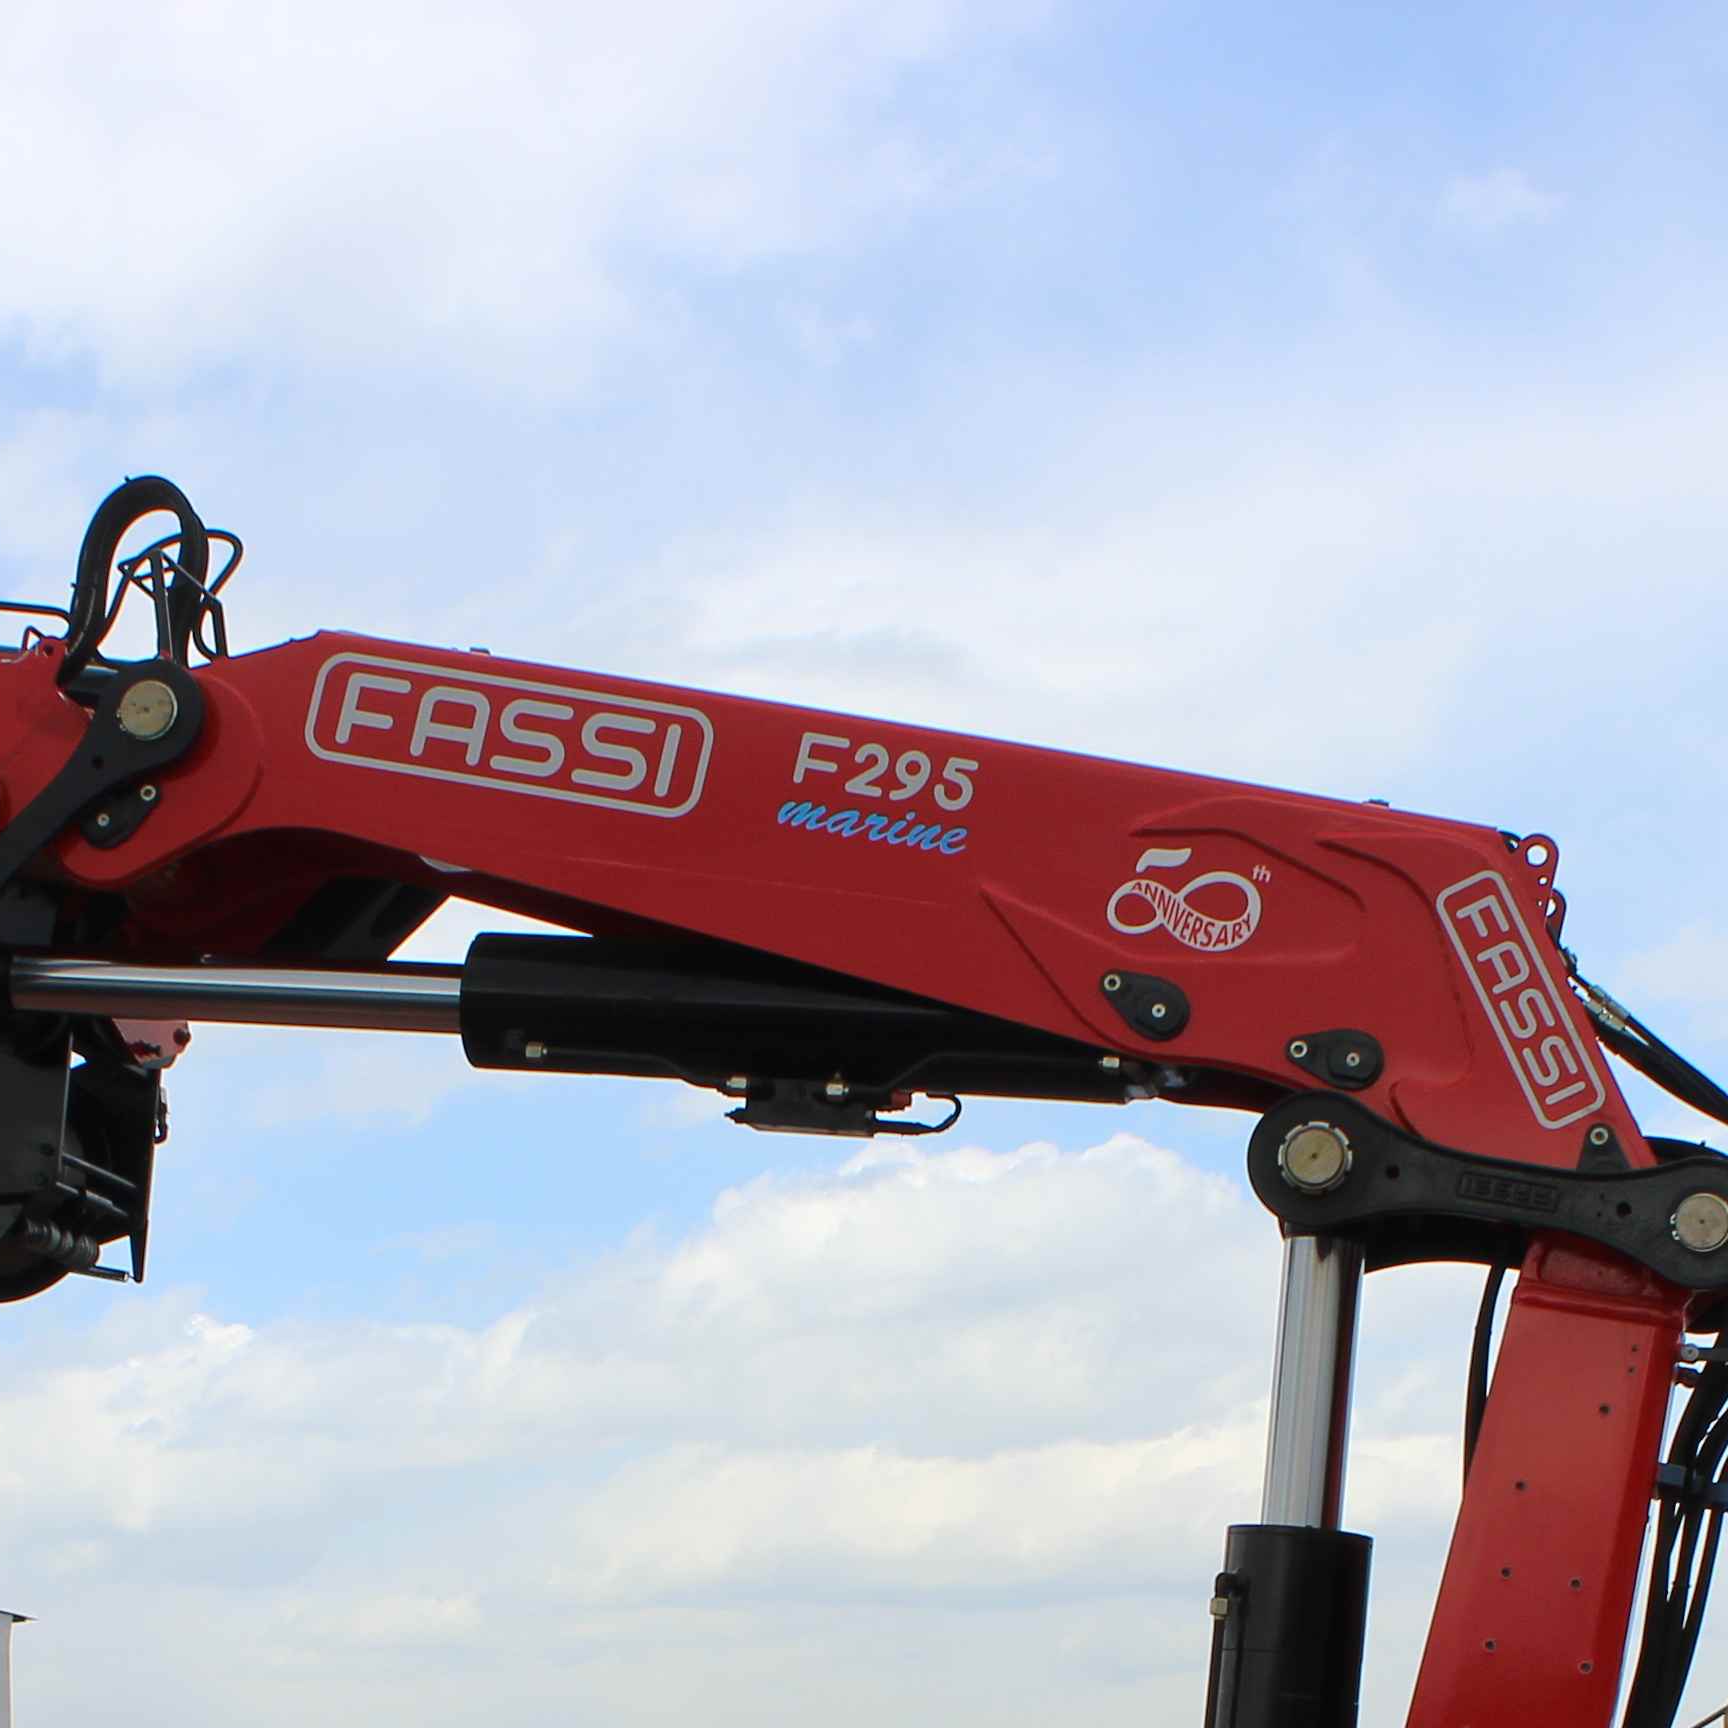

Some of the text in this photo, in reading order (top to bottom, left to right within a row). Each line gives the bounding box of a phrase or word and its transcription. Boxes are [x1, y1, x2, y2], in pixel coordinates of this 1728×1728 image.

[335, 672, 681, 798] FASSI
[793, 732, 979, 811] F295
[777, 801, 968, 855] marine
[1252, 864, 1271, 883] th
[1129, 881, 1252, 948] ANNIVERSARY
[1456, 895, 1586, 1105] FASSI
